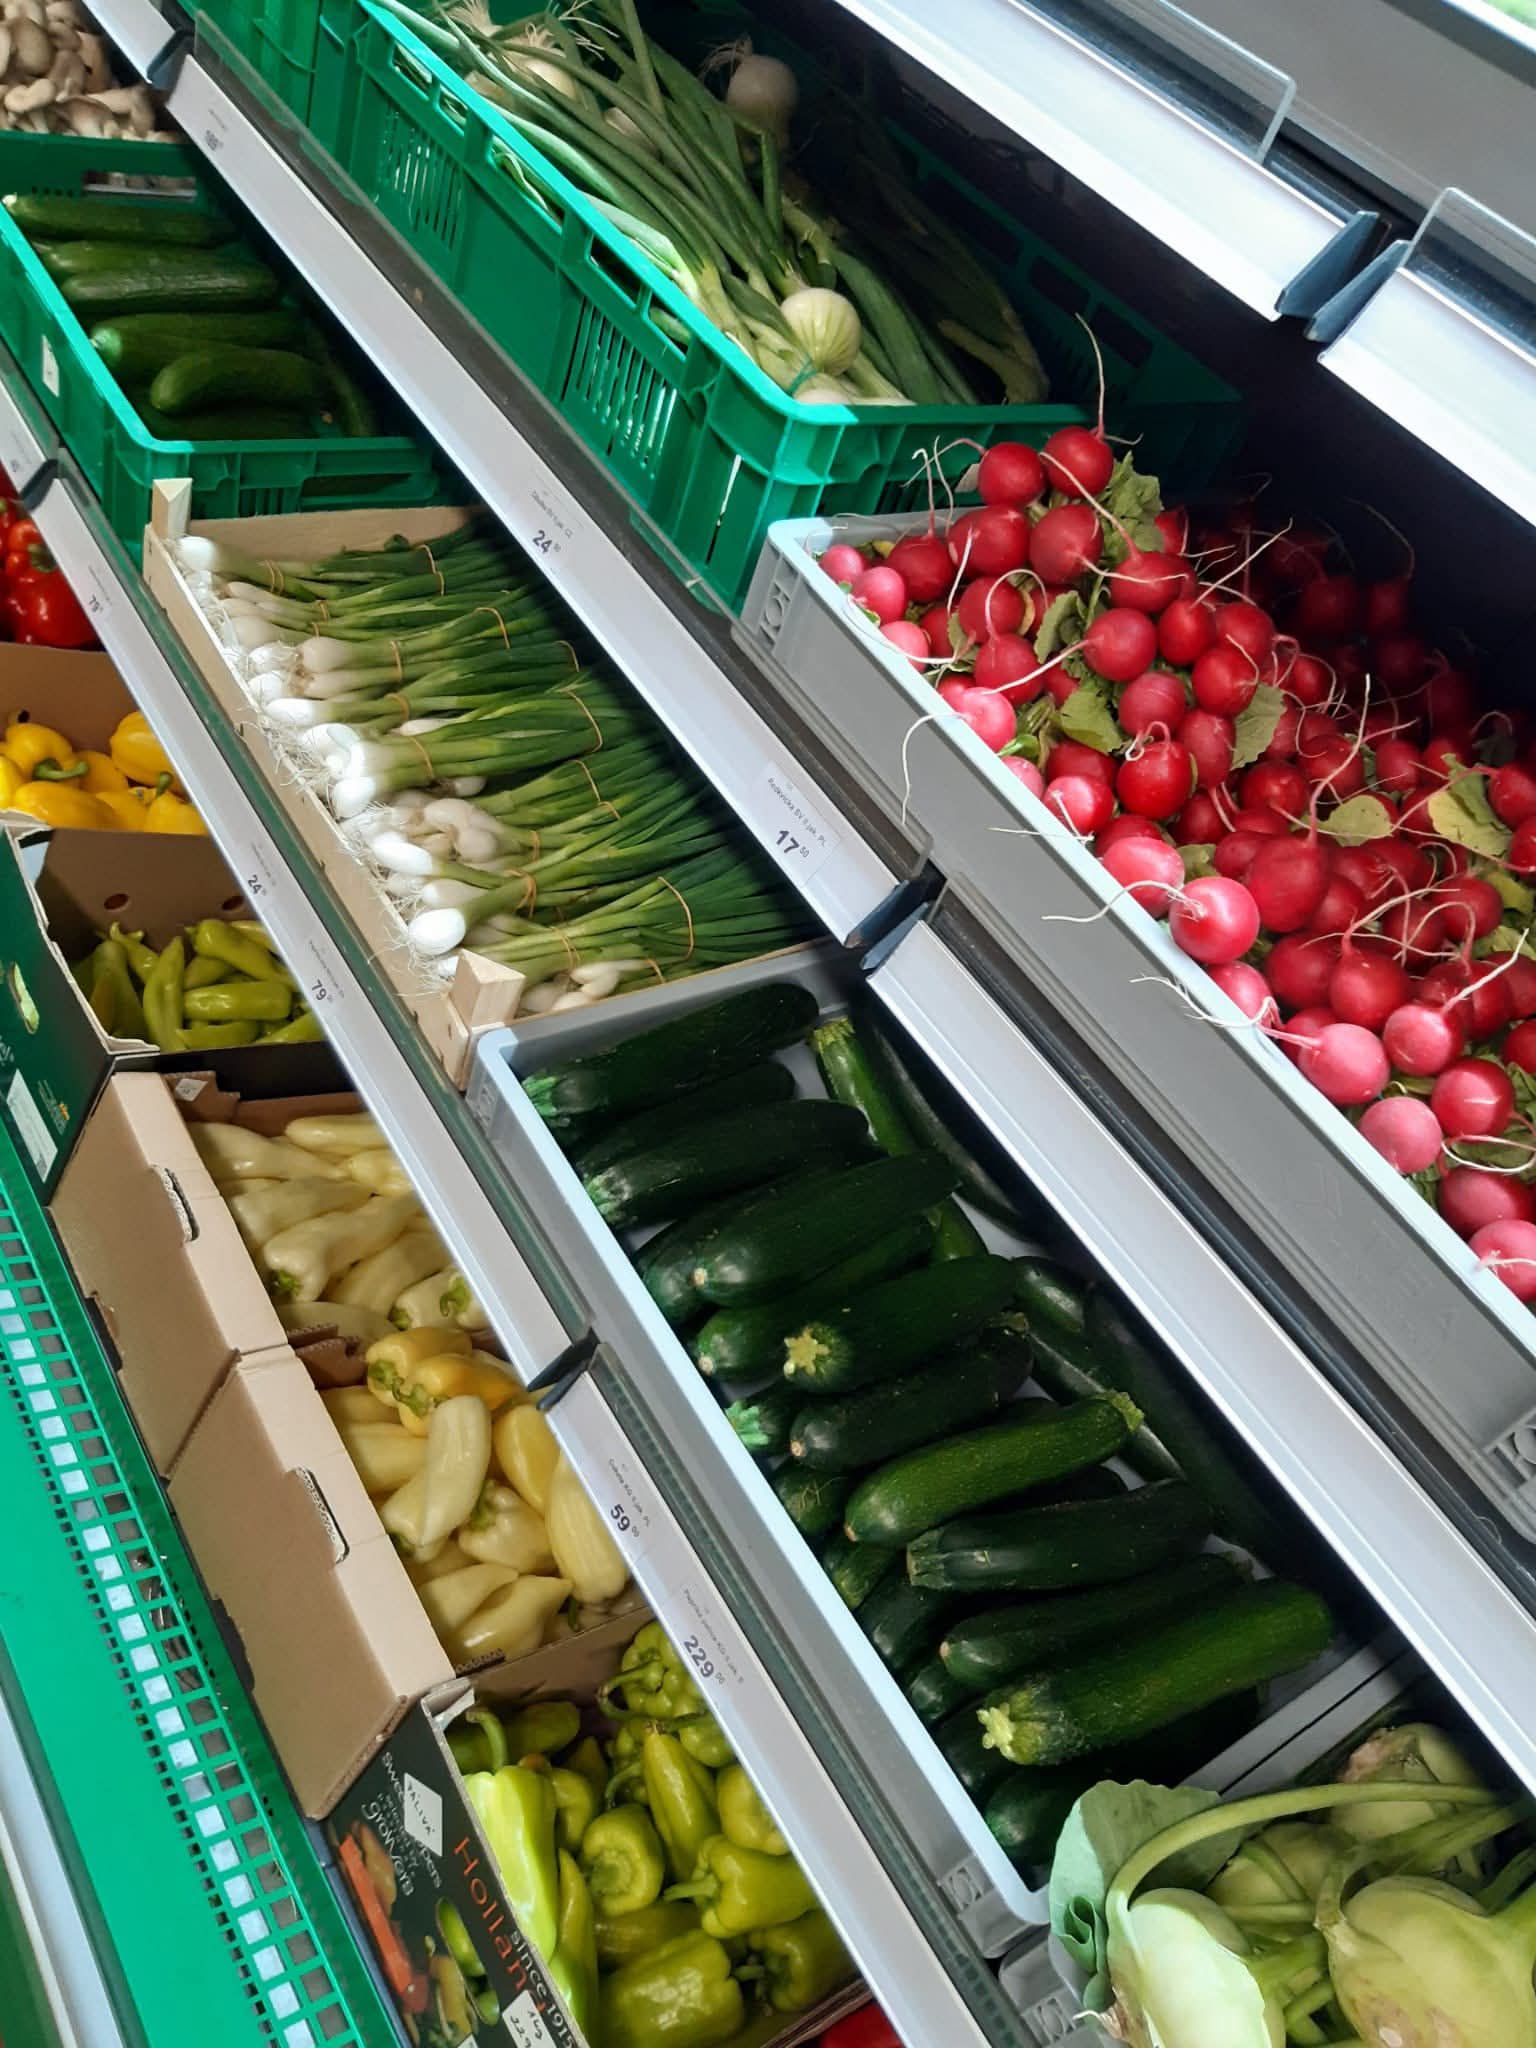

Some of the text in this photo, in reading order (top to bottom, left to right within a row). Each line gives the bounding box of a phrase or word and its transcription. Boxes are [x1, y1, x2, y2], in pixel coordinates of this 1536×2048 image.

[532, 529, 553, 554] 24
[776, 829, 800, 854] 17
[799, 845, 810, 859] 50
[248, 874, 263, 895] 24
[312, 978, 328, 1001] 79
[610, 1503, 631, 1532] 59
[683, 1635, 715, 1678] 229
[508, 1930, 576, 2048] since 1915
